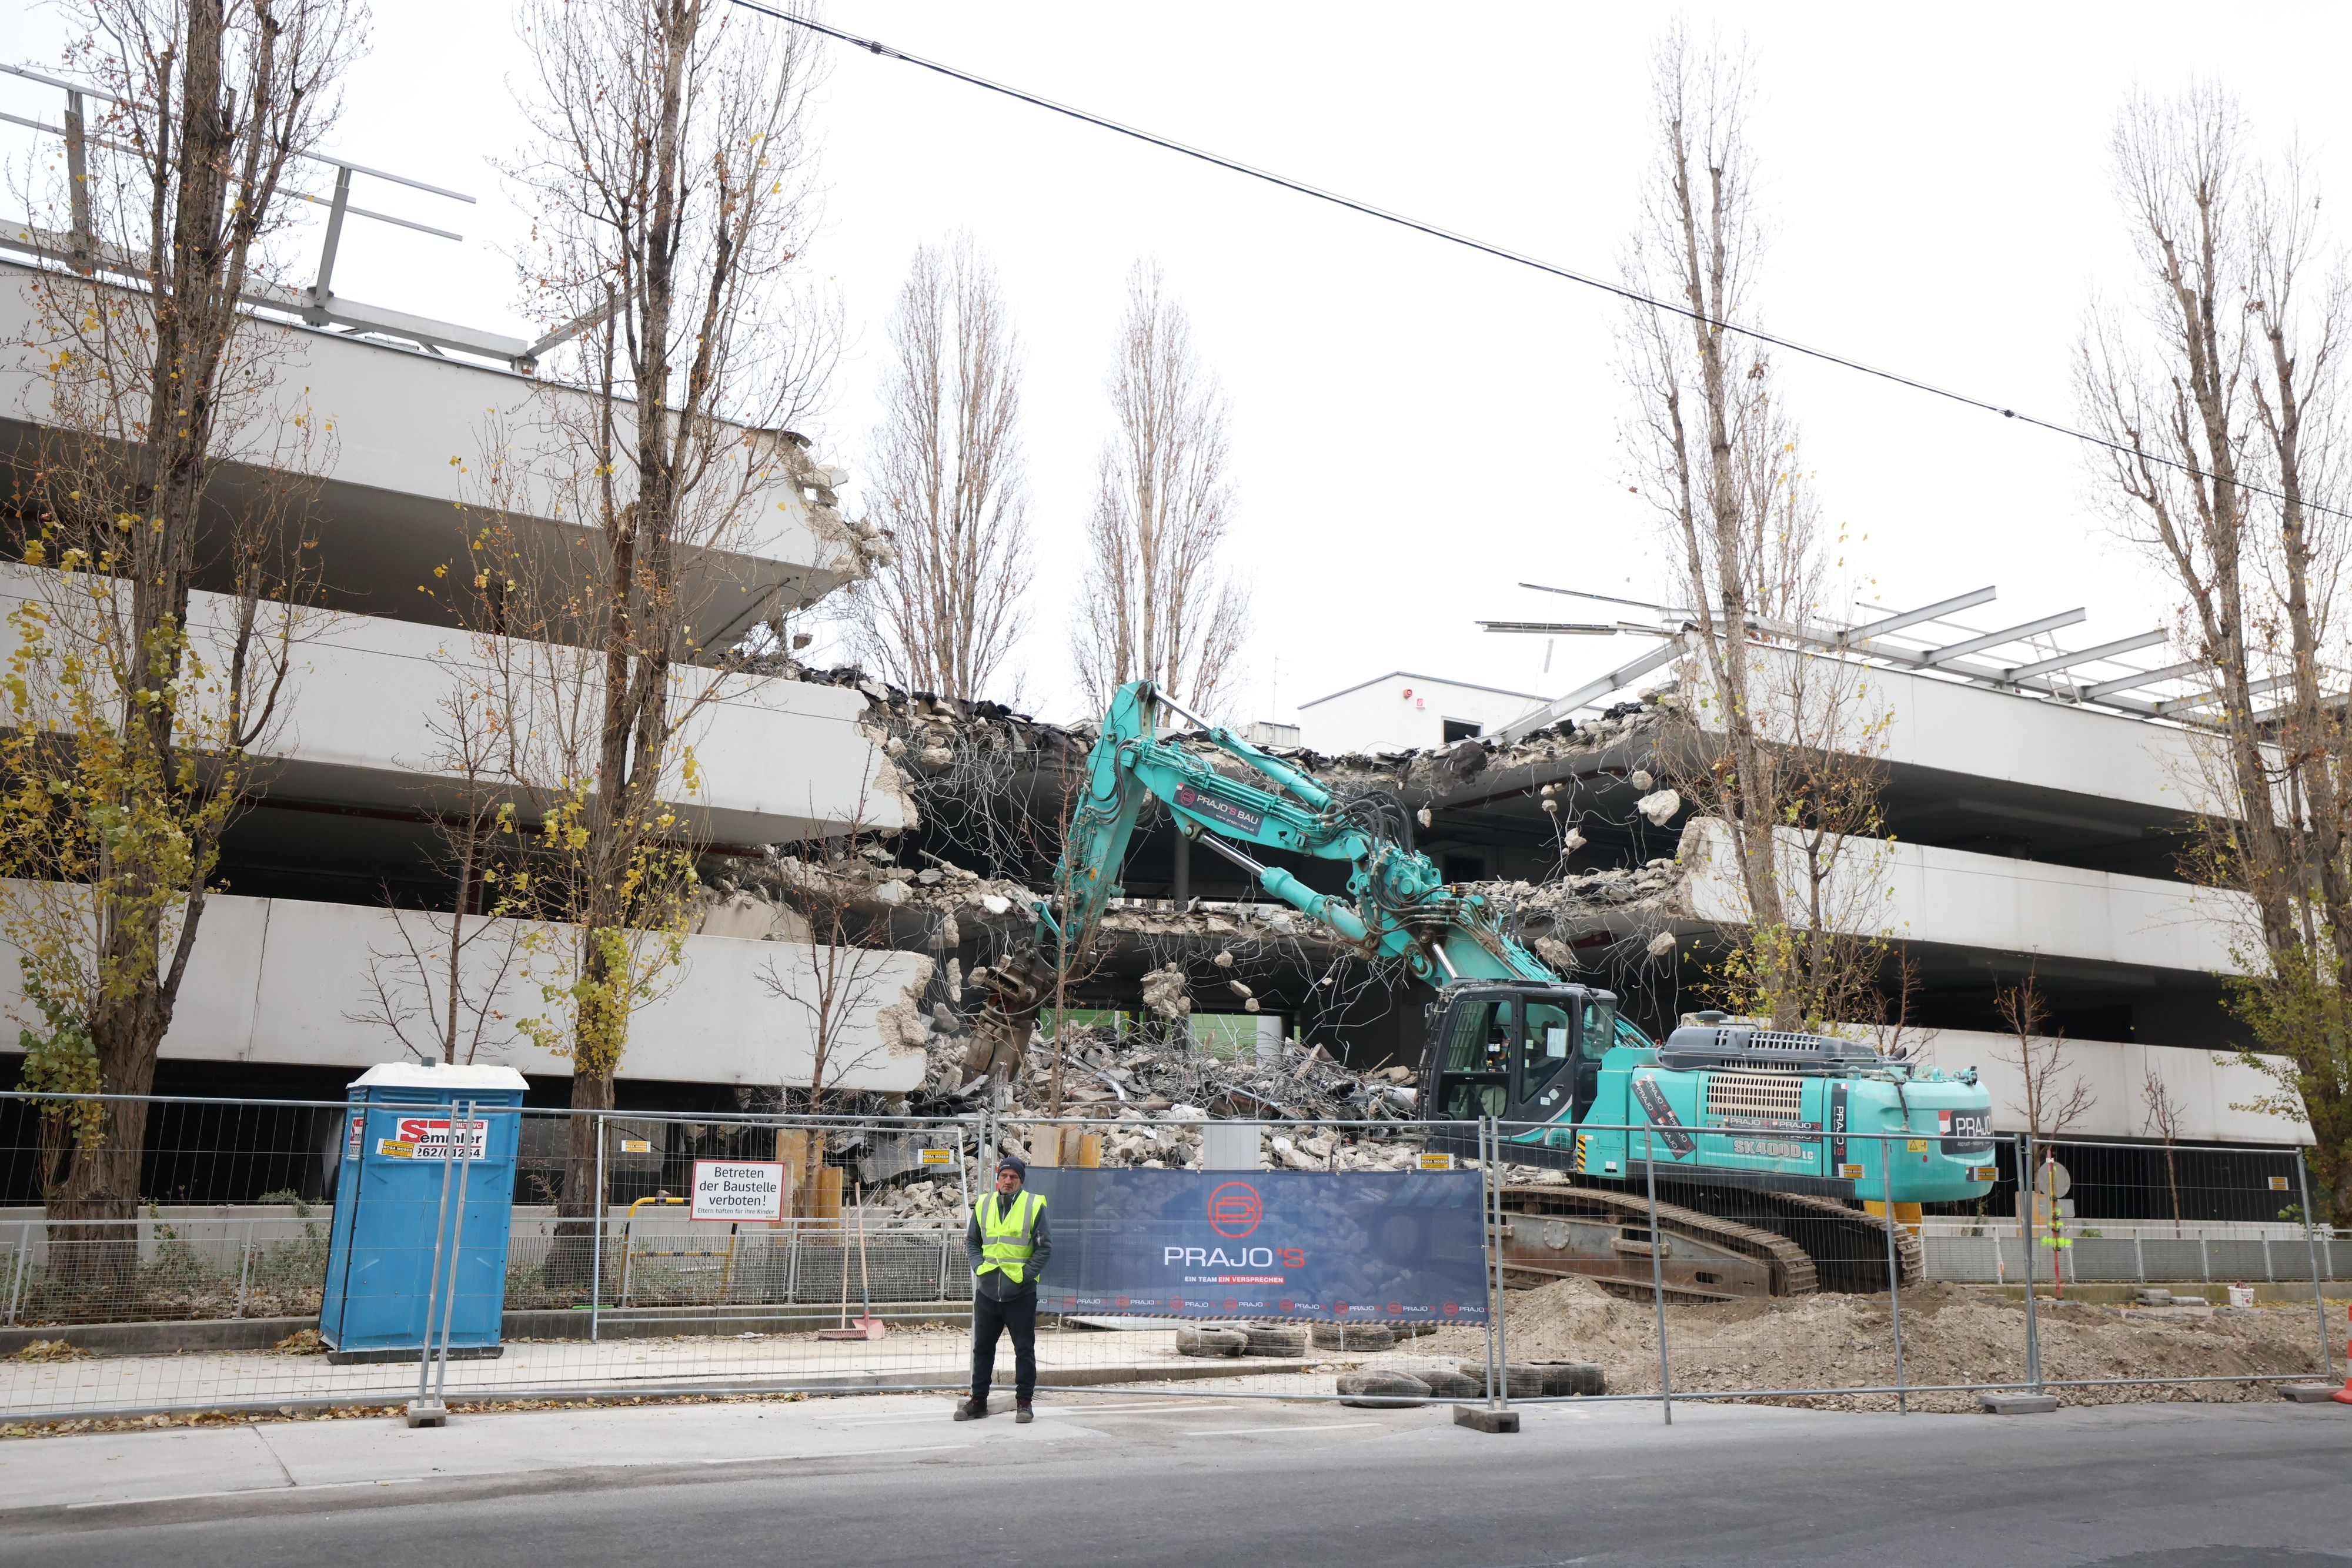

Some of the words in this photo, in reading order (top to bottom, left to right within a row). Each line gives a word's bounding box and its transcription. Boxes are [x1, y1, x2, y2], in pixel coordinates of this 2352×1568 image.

[1197, 794, 1237, 815] PRAJO'S
[1237, 810, 1259, 824] BAU
[1779, 1121, 1821, 1129] PRAJO'S
[1733, 1139, 1801, 1158] SK400D
[1802, 1151, 1813, 1160] LC
[714, 1166, 764, 1178] Betreten
[699, 1180, 719, 1191] der
[723, 1181, 777, 1192] Baustelle
[709, 1195, 766, 1206] verboten!
